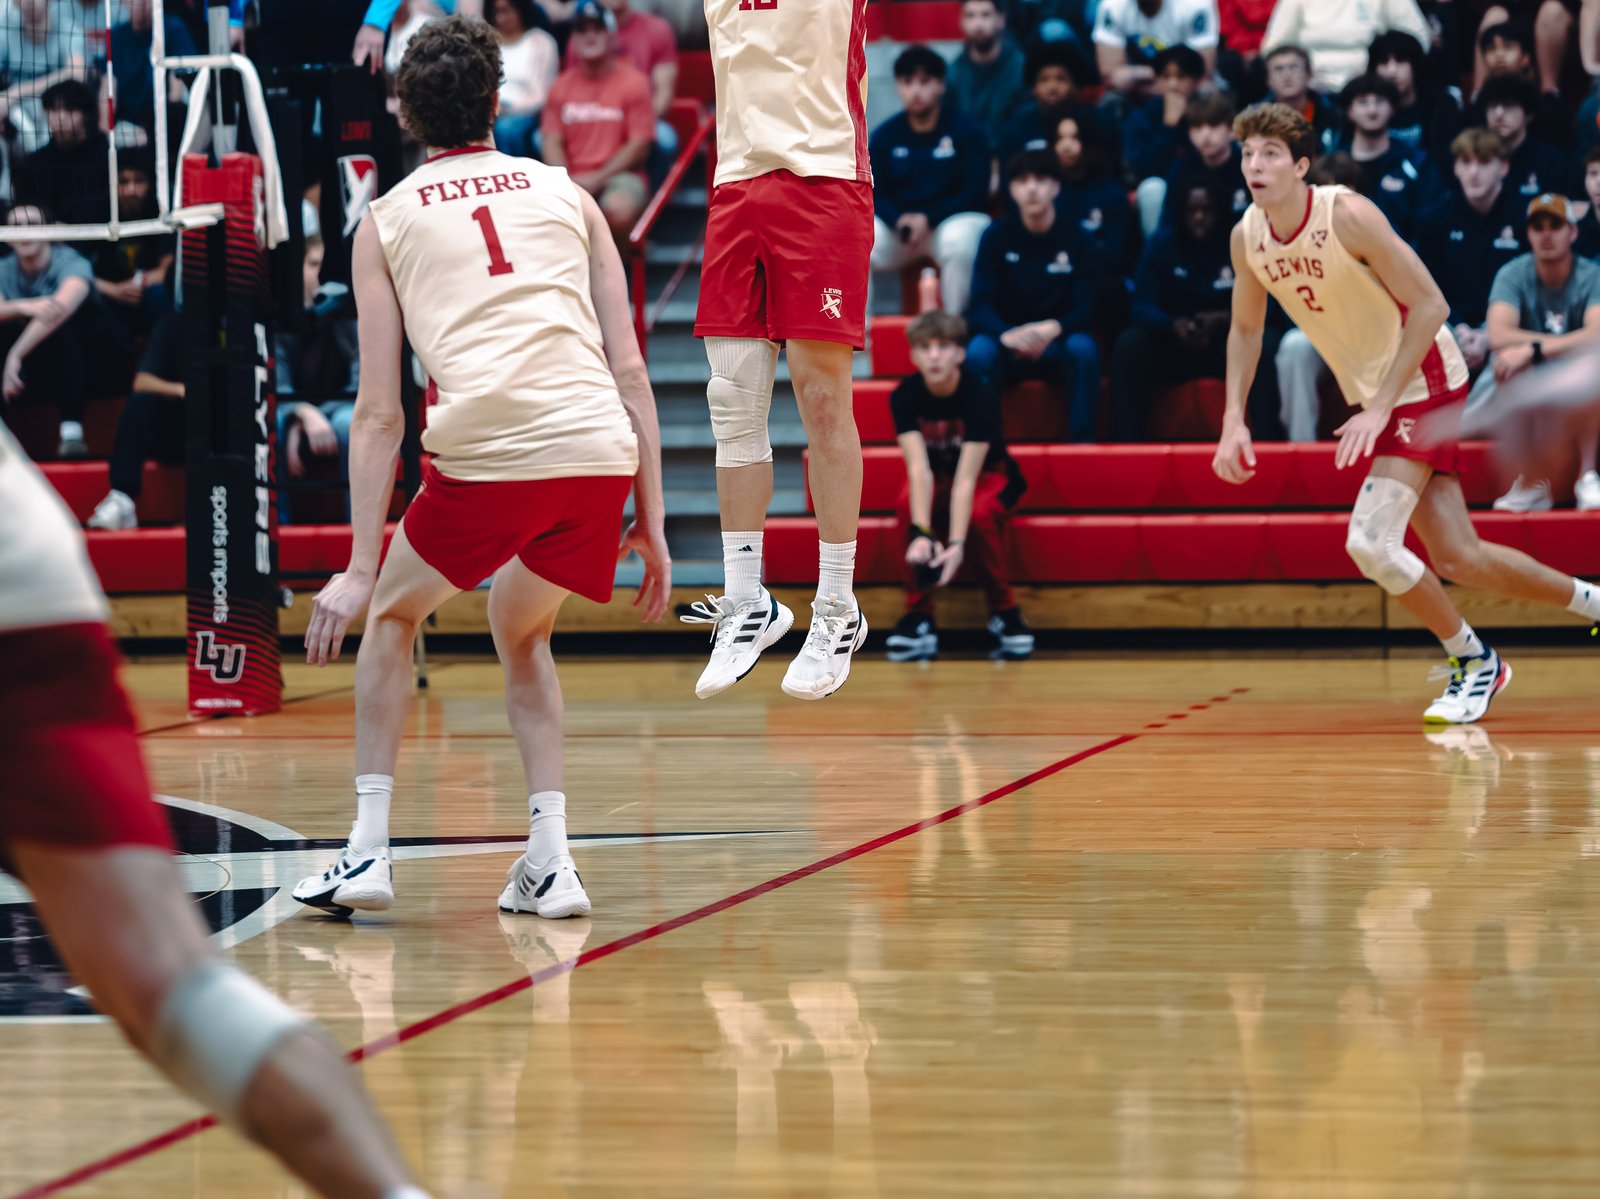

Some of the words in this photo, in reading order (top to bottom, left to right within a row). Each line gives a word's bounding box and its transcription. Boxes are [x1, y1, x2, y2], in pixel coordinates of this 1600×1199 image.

[416, 171, 532, 207] FLYERS
[471, 205, 514, 277] 1
[1263, 256, 1325, 283] LEWIS
[1296, 285, 1324, 312] 2
[253, 322, 270, 575] FLYERS
[210, 485, 229, 546] sports
[210, 549, 229, 623] imports
[195, 630, 246, 684] LU
